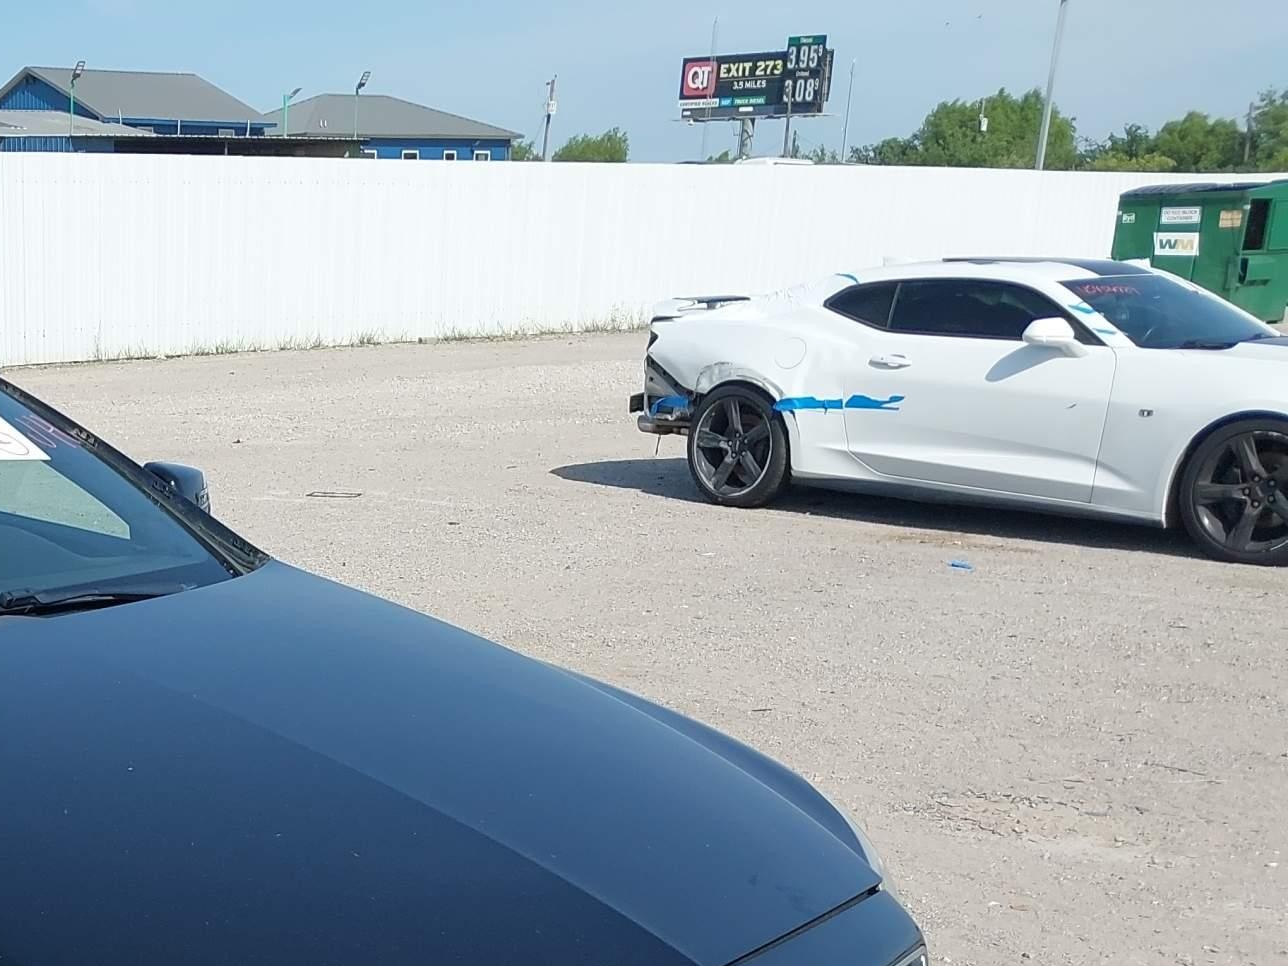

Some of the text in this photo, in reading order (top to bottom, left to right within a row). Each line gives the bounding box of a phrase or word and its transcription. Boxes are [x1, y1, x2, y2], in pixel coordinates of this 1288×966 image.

[719, 62, 753, 78] EXIT
[755, 60, 783, 76] 273
[687, 66, 712, 90] QT
[744, 79, 767, 89] MILES
[1159, 238, 1194, 250] WM
